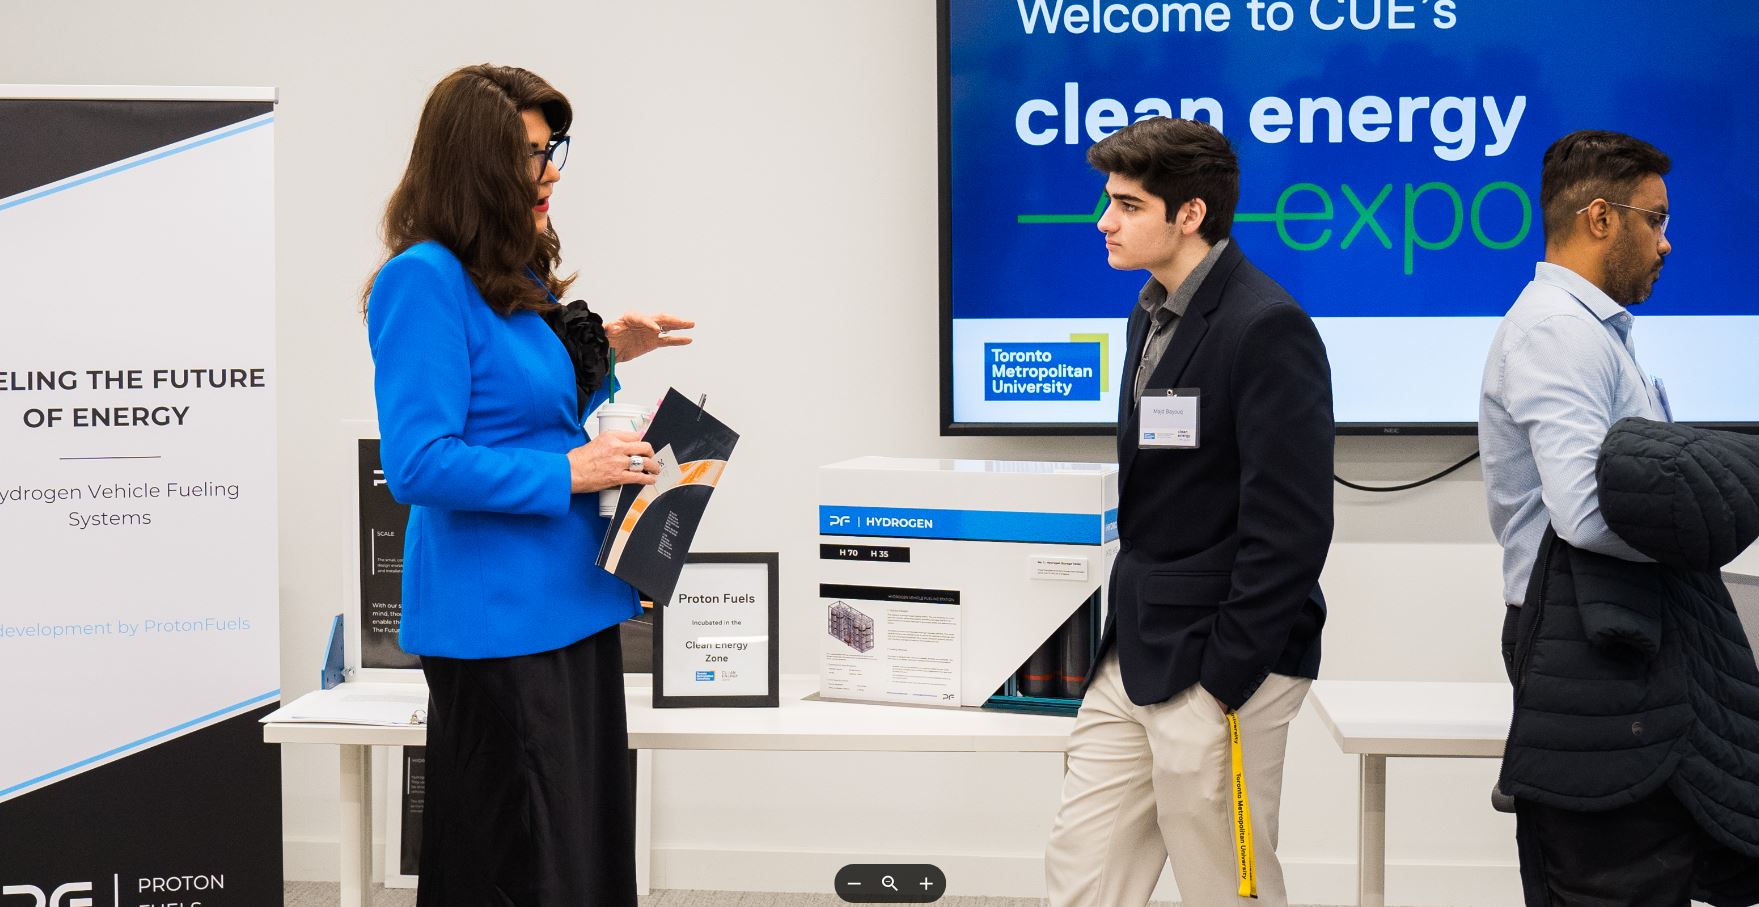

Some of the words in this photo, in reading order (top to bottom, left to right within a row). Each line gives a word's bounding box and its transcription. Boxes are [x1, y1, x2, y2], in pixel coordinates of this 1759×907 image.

[1017, 0, 1231, 34] Welcome
[1246, 1, 1295, 31] to
[1309, 0, 1457, 31] CUE's
[1015, 82, 1223, 146] clean
[1249, 95, 1527, 161] energy
[1275, 181, 1532, 275] expo
[991, 348, 1052, 362] Toronto
[86, 370, 143, 389] THE
[153, 368, 266, 388] FUTURE
[991, 364, 1093, 381] Metropolitan
[992, 380, 1073, 396] University
[23, 408, 63, 428] OF
[73, 406, 189, 427] ENERGY
[88, 482, 160, 499] Vehicle
[167, 481, 239, 499] Fueling
[69, 511, 152, 530] Systems
[866, 517, 933, 529] HYDROGEN
[839, 549, 846, 557] H
[847, 549, 858, 557] 70
[870, 550, 877, 558] H
[878, 550, 889, 558] 35
[678, 593, 720, 604] Proton
[723, 593, 755, 603] Fuels
[0, 621, 112, 639] evelopment
[118, 619, 139, 636] by
[145, 616, 250, 633] ProtonFuels
[705, 654, 729, 662] Zone
[1237, 800, 1246, 844] Metropolitan
[138, 874, 224, 893] PROTON
